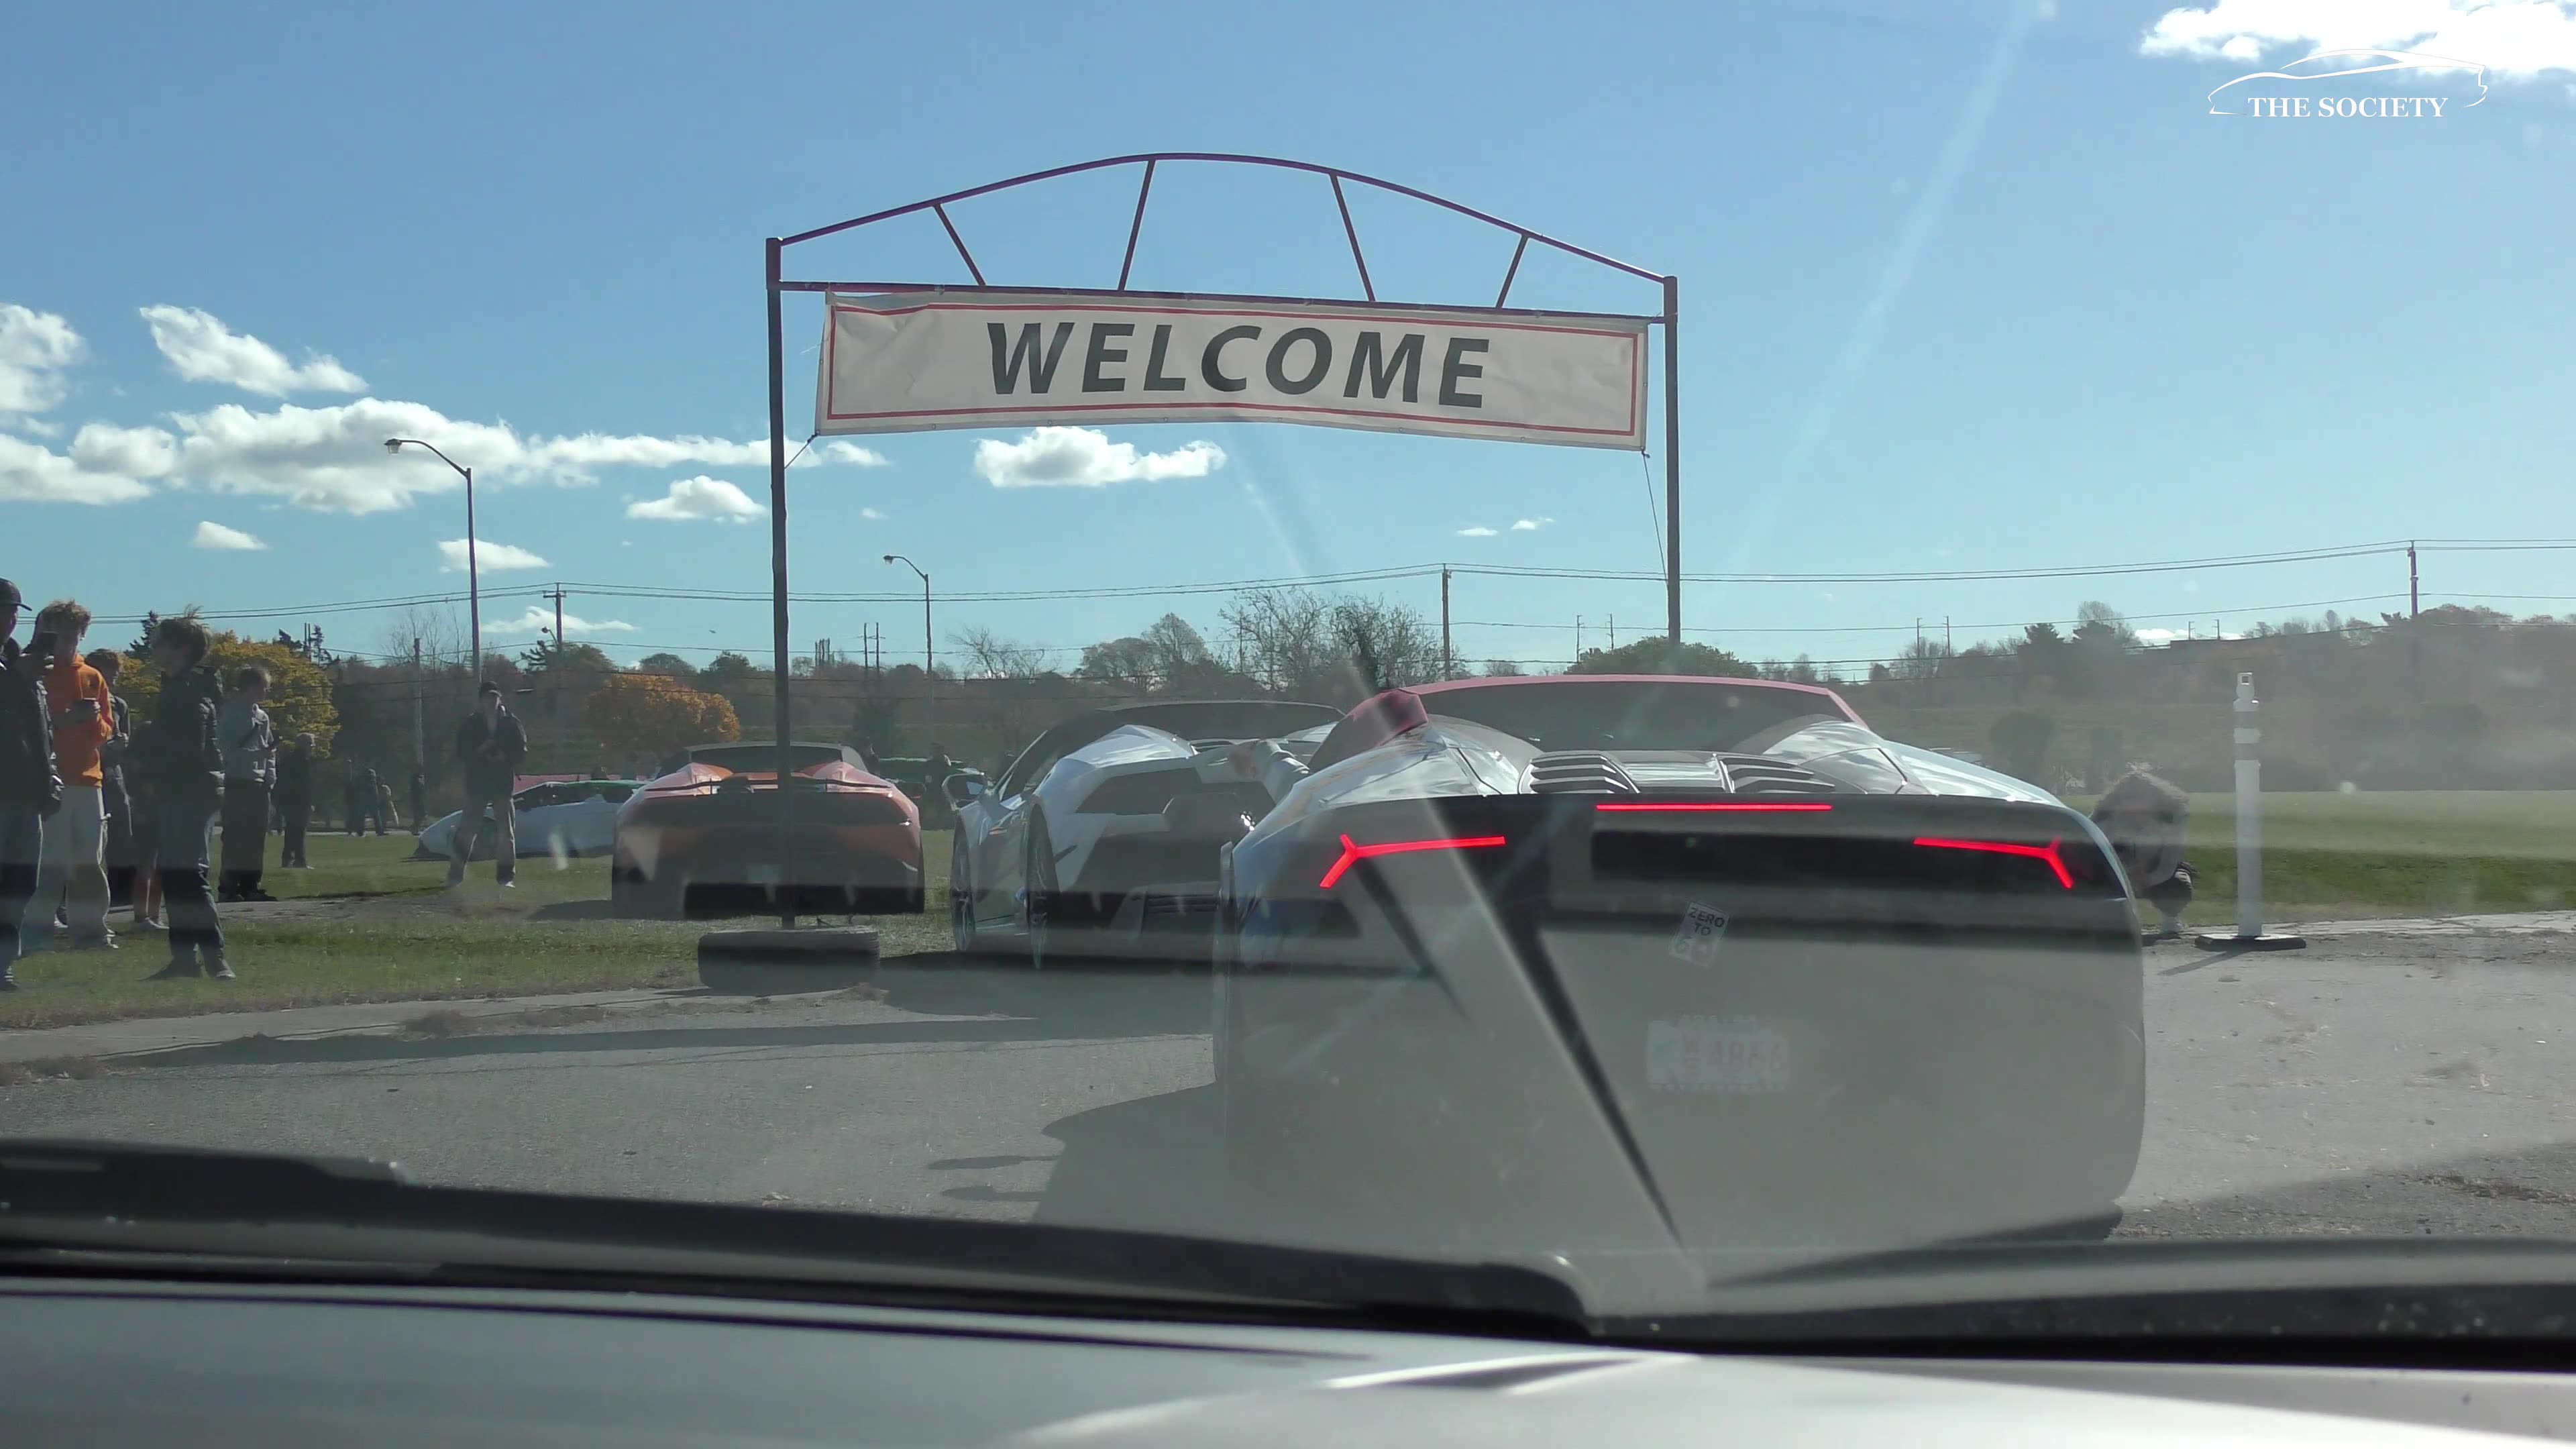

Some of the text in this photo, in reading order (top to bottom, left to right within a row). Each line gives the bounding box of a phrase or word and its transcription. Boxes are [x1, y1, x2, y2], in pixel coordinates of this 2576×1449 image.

[987, 322, 1490, 408] WELCOME
[1688, 907, 1725, 928] ZERO
[1695, 922, 1712, 936] TO
